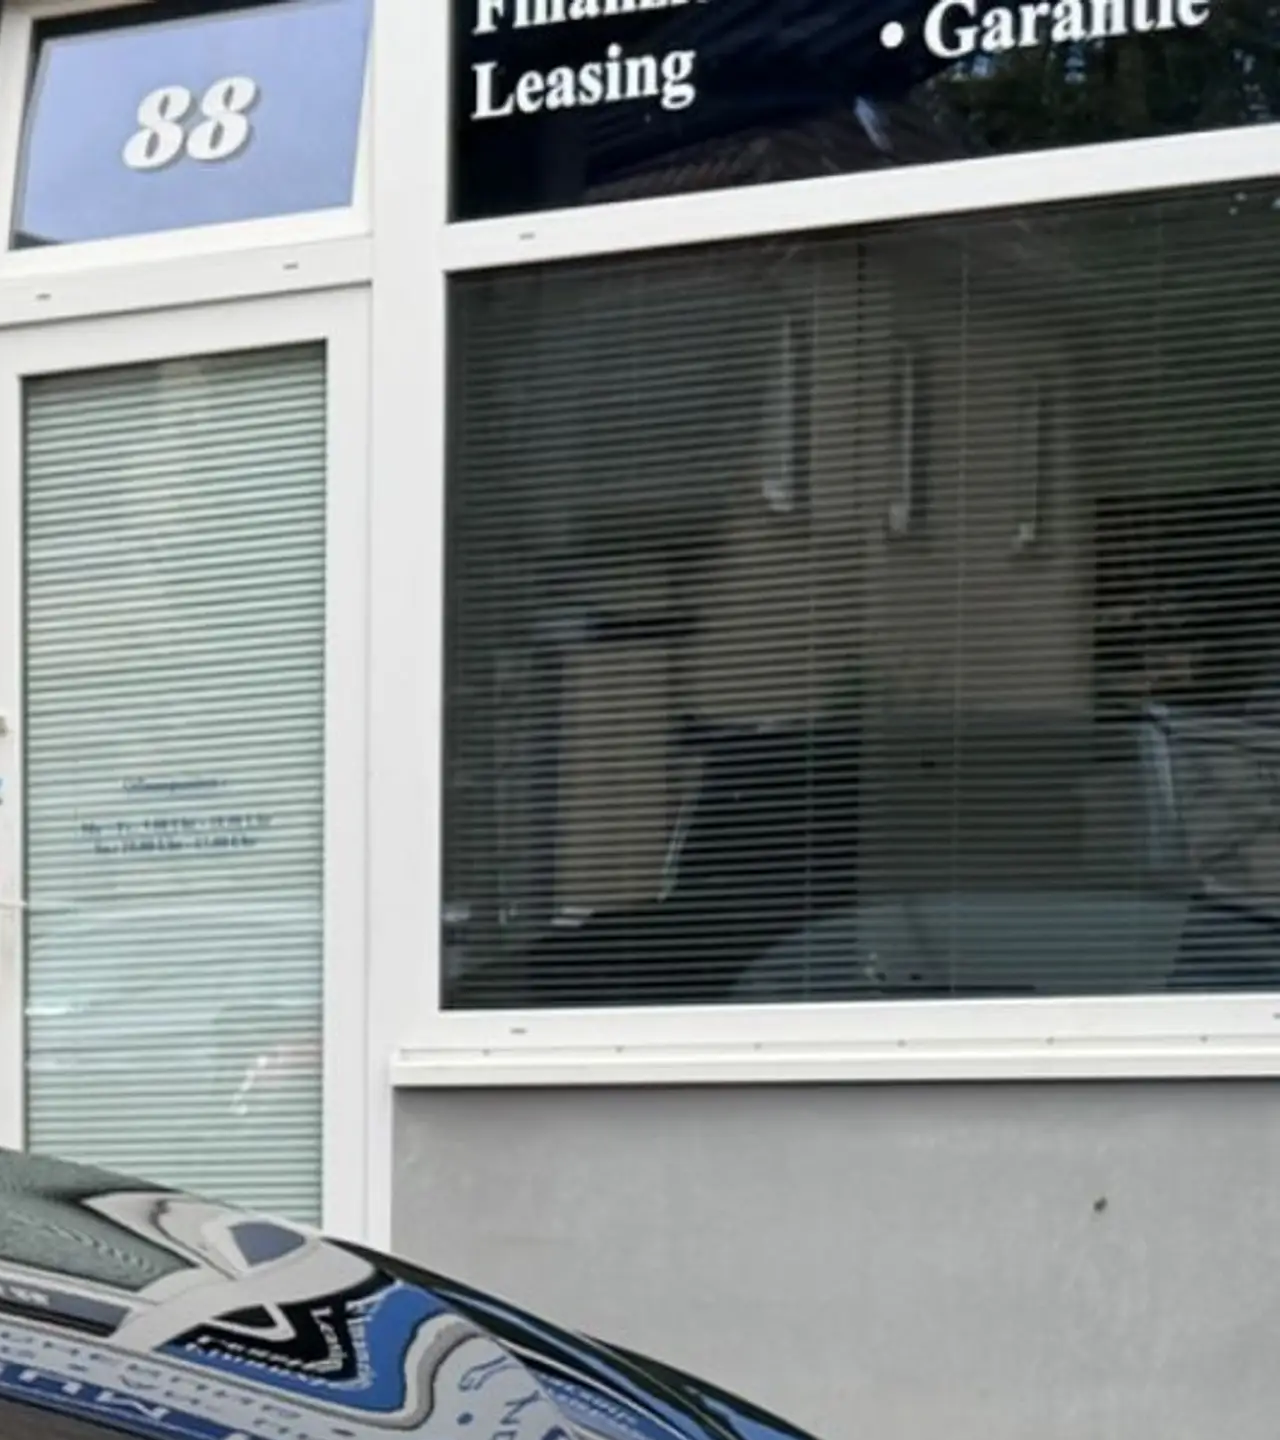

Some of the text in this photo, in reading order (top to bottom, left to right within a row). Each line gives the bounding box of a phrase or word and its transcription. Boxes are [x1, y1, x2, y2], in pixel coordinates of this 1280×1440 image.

[470, 0, 707, 35] Fina
[470, 42, 696, 121] Leasing
[122, 76, 259, 170] 88
